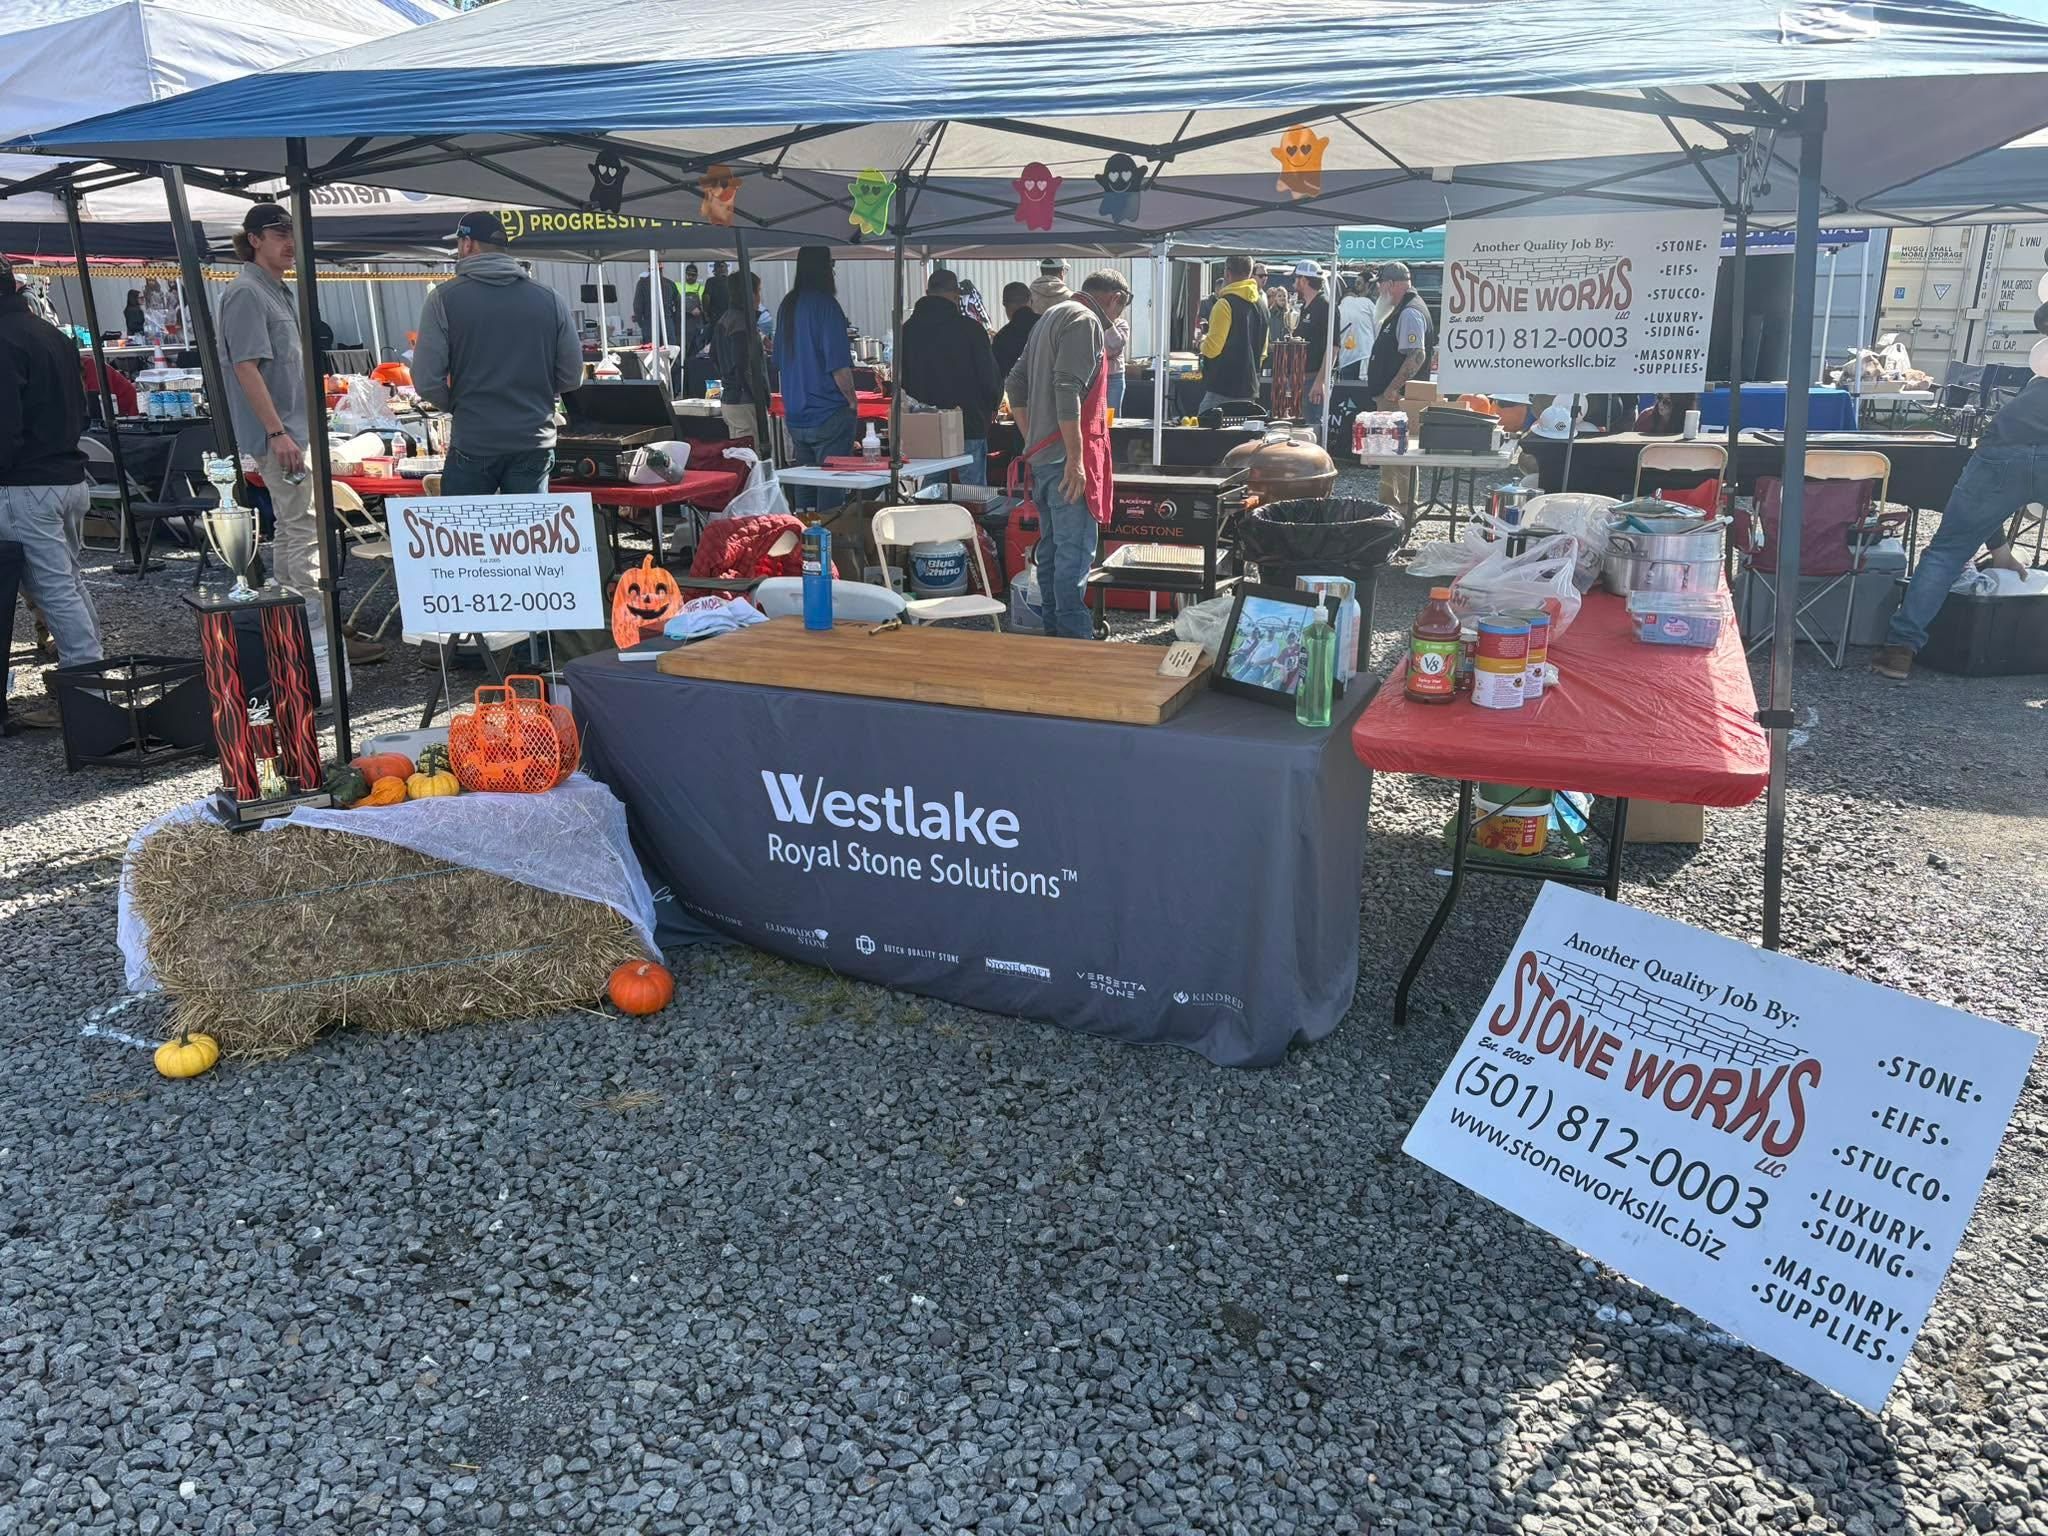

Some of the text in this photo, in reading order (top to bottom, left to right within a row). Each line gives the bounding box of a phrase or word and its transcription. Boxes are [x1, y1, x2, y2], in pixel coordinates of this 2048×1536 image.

[1345, 236, 1377, 249] and
[1380, 236, 1424, 249] CPAs
[1473, 238, 1614, 253] Another Quality Job By:
[1660, 239, 1703, 252] STONE
[2019, 237, 2042, 247] LVNU
[1665, 264, 1693, 276] EIFS
[1449, 257, 1632, 314] STONE WORKS
[1652, 287, 1700, 300] STUCCO
[2000, 290, 2016, 300] TARE
[1614, 311, 1631, 320] LLC
[1998, 301, 2009, 311] NET
[1465, 315, 1484, 323] 2005
[1649, 311, 1699, 323] LUXURY
[1447, 326, 1628, 352] (501) 812-0003
[1650, 325, 1694, 338] SIDING
[1454, 354, 1617, 369] www.stoneworksllc.biz
[1639, 349, 1700, 361] MASONRY
[1638, 362, 1698, 374] SUPPLIES
[403, 505, 580, 559] STONE WORKS
[432, 565, 564, 579] The Professional Way!
[927, 559, 955, 568] Blue
[423, 592, 576, 614] 501-812-0003
[1424, 656, 1440, 672] V8
[761, 769, 1020, 849] Westlake
[768, 832, 841, 873] Royal
[848, 841, 922, 880] Stone
[765, 921, 817, 938] ELDORADO
[798, 936, 829, 949] STONE
[883, 943, 960, 964] DUTCH QUALITY STONE
[1076, 970, 1147, 992] VERSETTA
[1089, 980, 1136, 999] STONE
[1563, 931, 1800, 1029] Another Quality Job By:
[1192, 991, 1244, 1010] KINDRED
[1478, 1036, 1535, 1066] Est. 2005
[1488, 950, 1822, 1158] STONE WORKS
[1886, 1055, 1973, 1104] STONE
[1880, 1106, 1940, 1145] EIFS
[1455, 1055, 1770, 1230] (501) 812-0003
[1754, 1156, 1787, 1178] LLC
[1839, 1145, 1941, 1202] STUCCO
[1450, 1106, 1727, 1261] www.stoneworksllc.biz
[1819, 1188, 1925, 1252] LUXURY
[1810, 1218, 1907, 1278] SIDING
[1772, 1255, 1902, 1335] MASONRY
[1759, 1282, 1888, 1361] SUPPLIES
